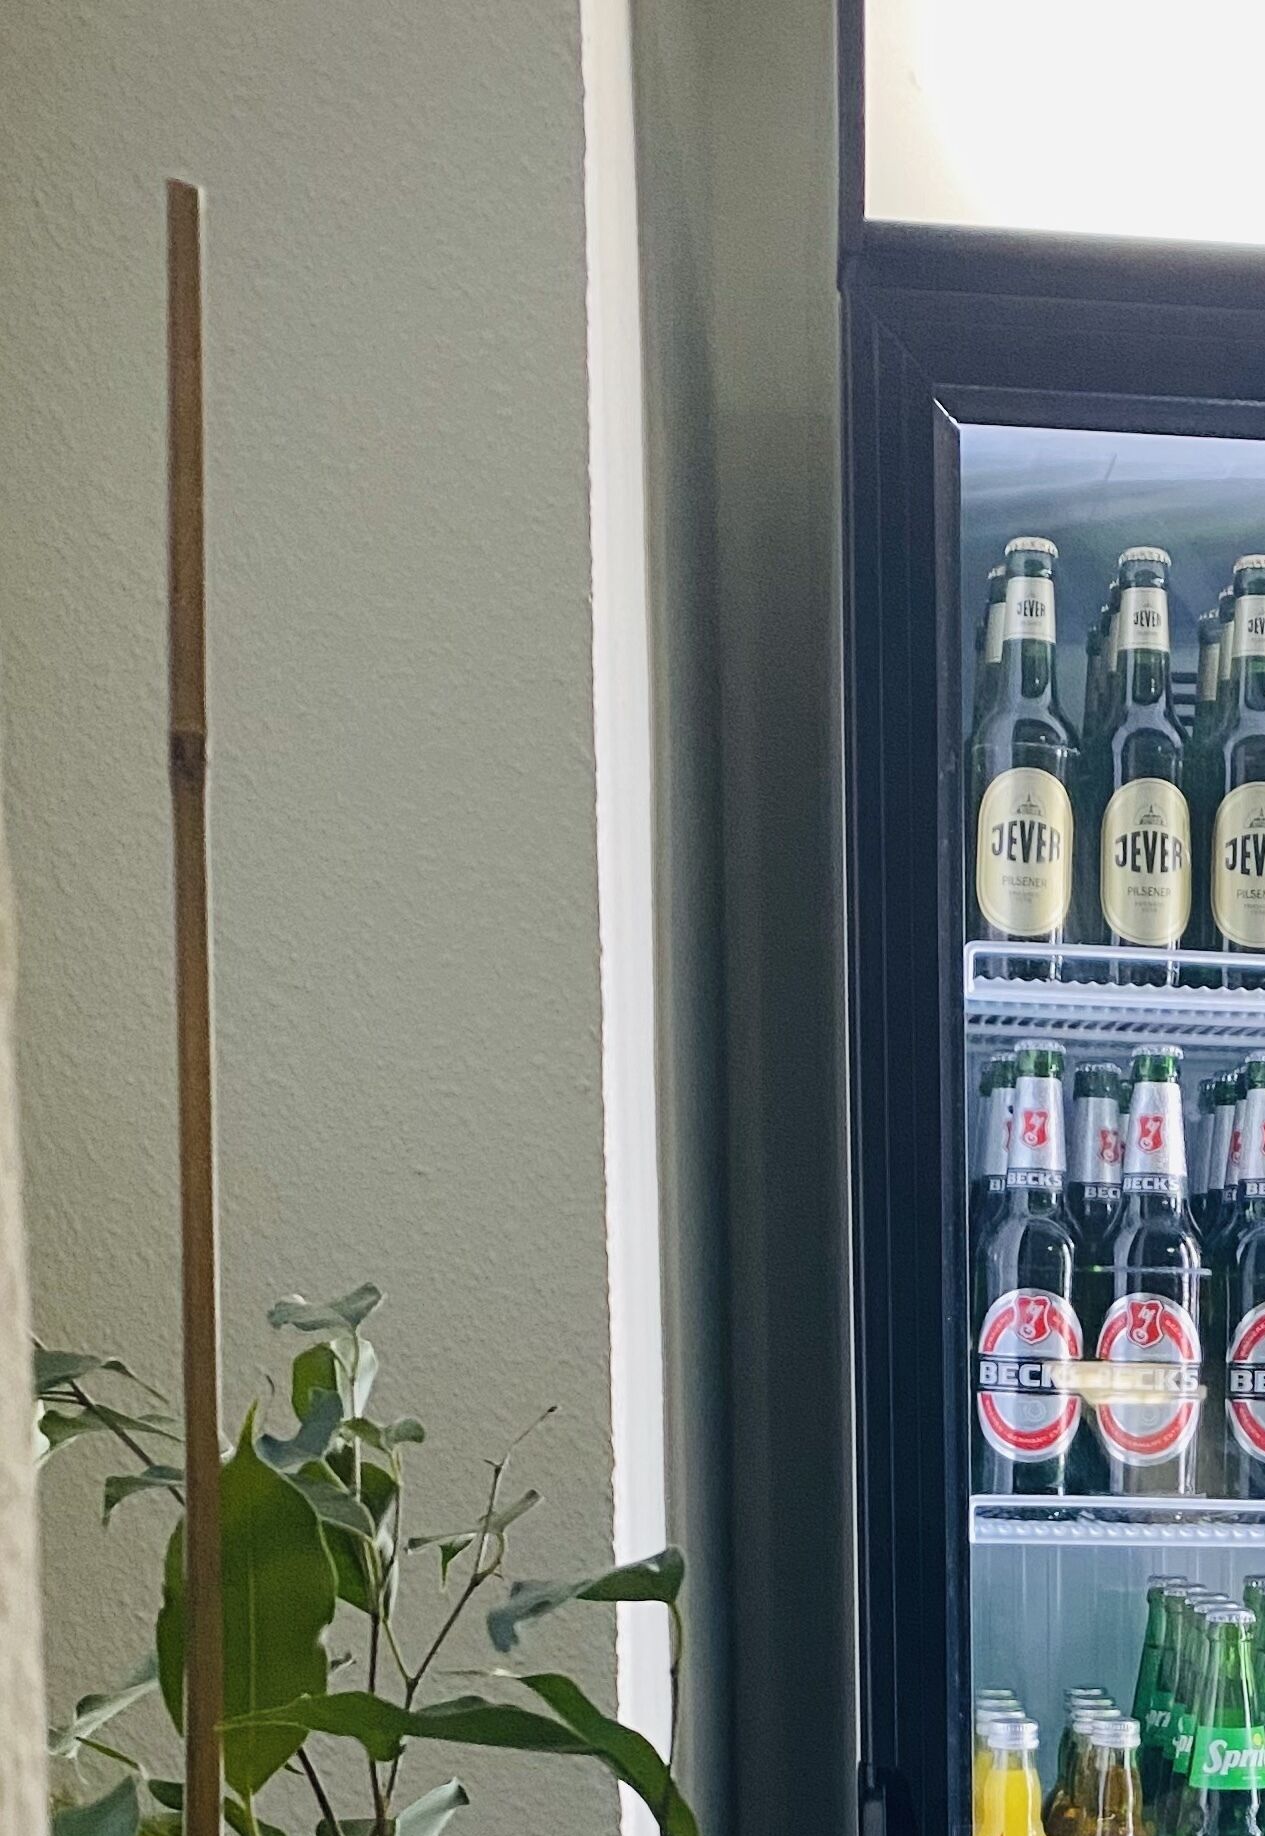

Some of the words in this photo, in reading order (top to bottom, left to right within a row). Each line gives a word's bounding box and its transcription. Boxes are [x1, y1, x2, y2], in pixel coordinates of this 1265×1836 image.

[1016, 599, 1046, 617] JEVER
[1133, 610, 1162, 628] JEVER
[991, 819, 1061, 864] JEVER
[1114, 830, 1183, 875] JEVER
[1002, 875, 1048, 889] PILSENER
[1127, 886, 1171, 897] PILSENER
